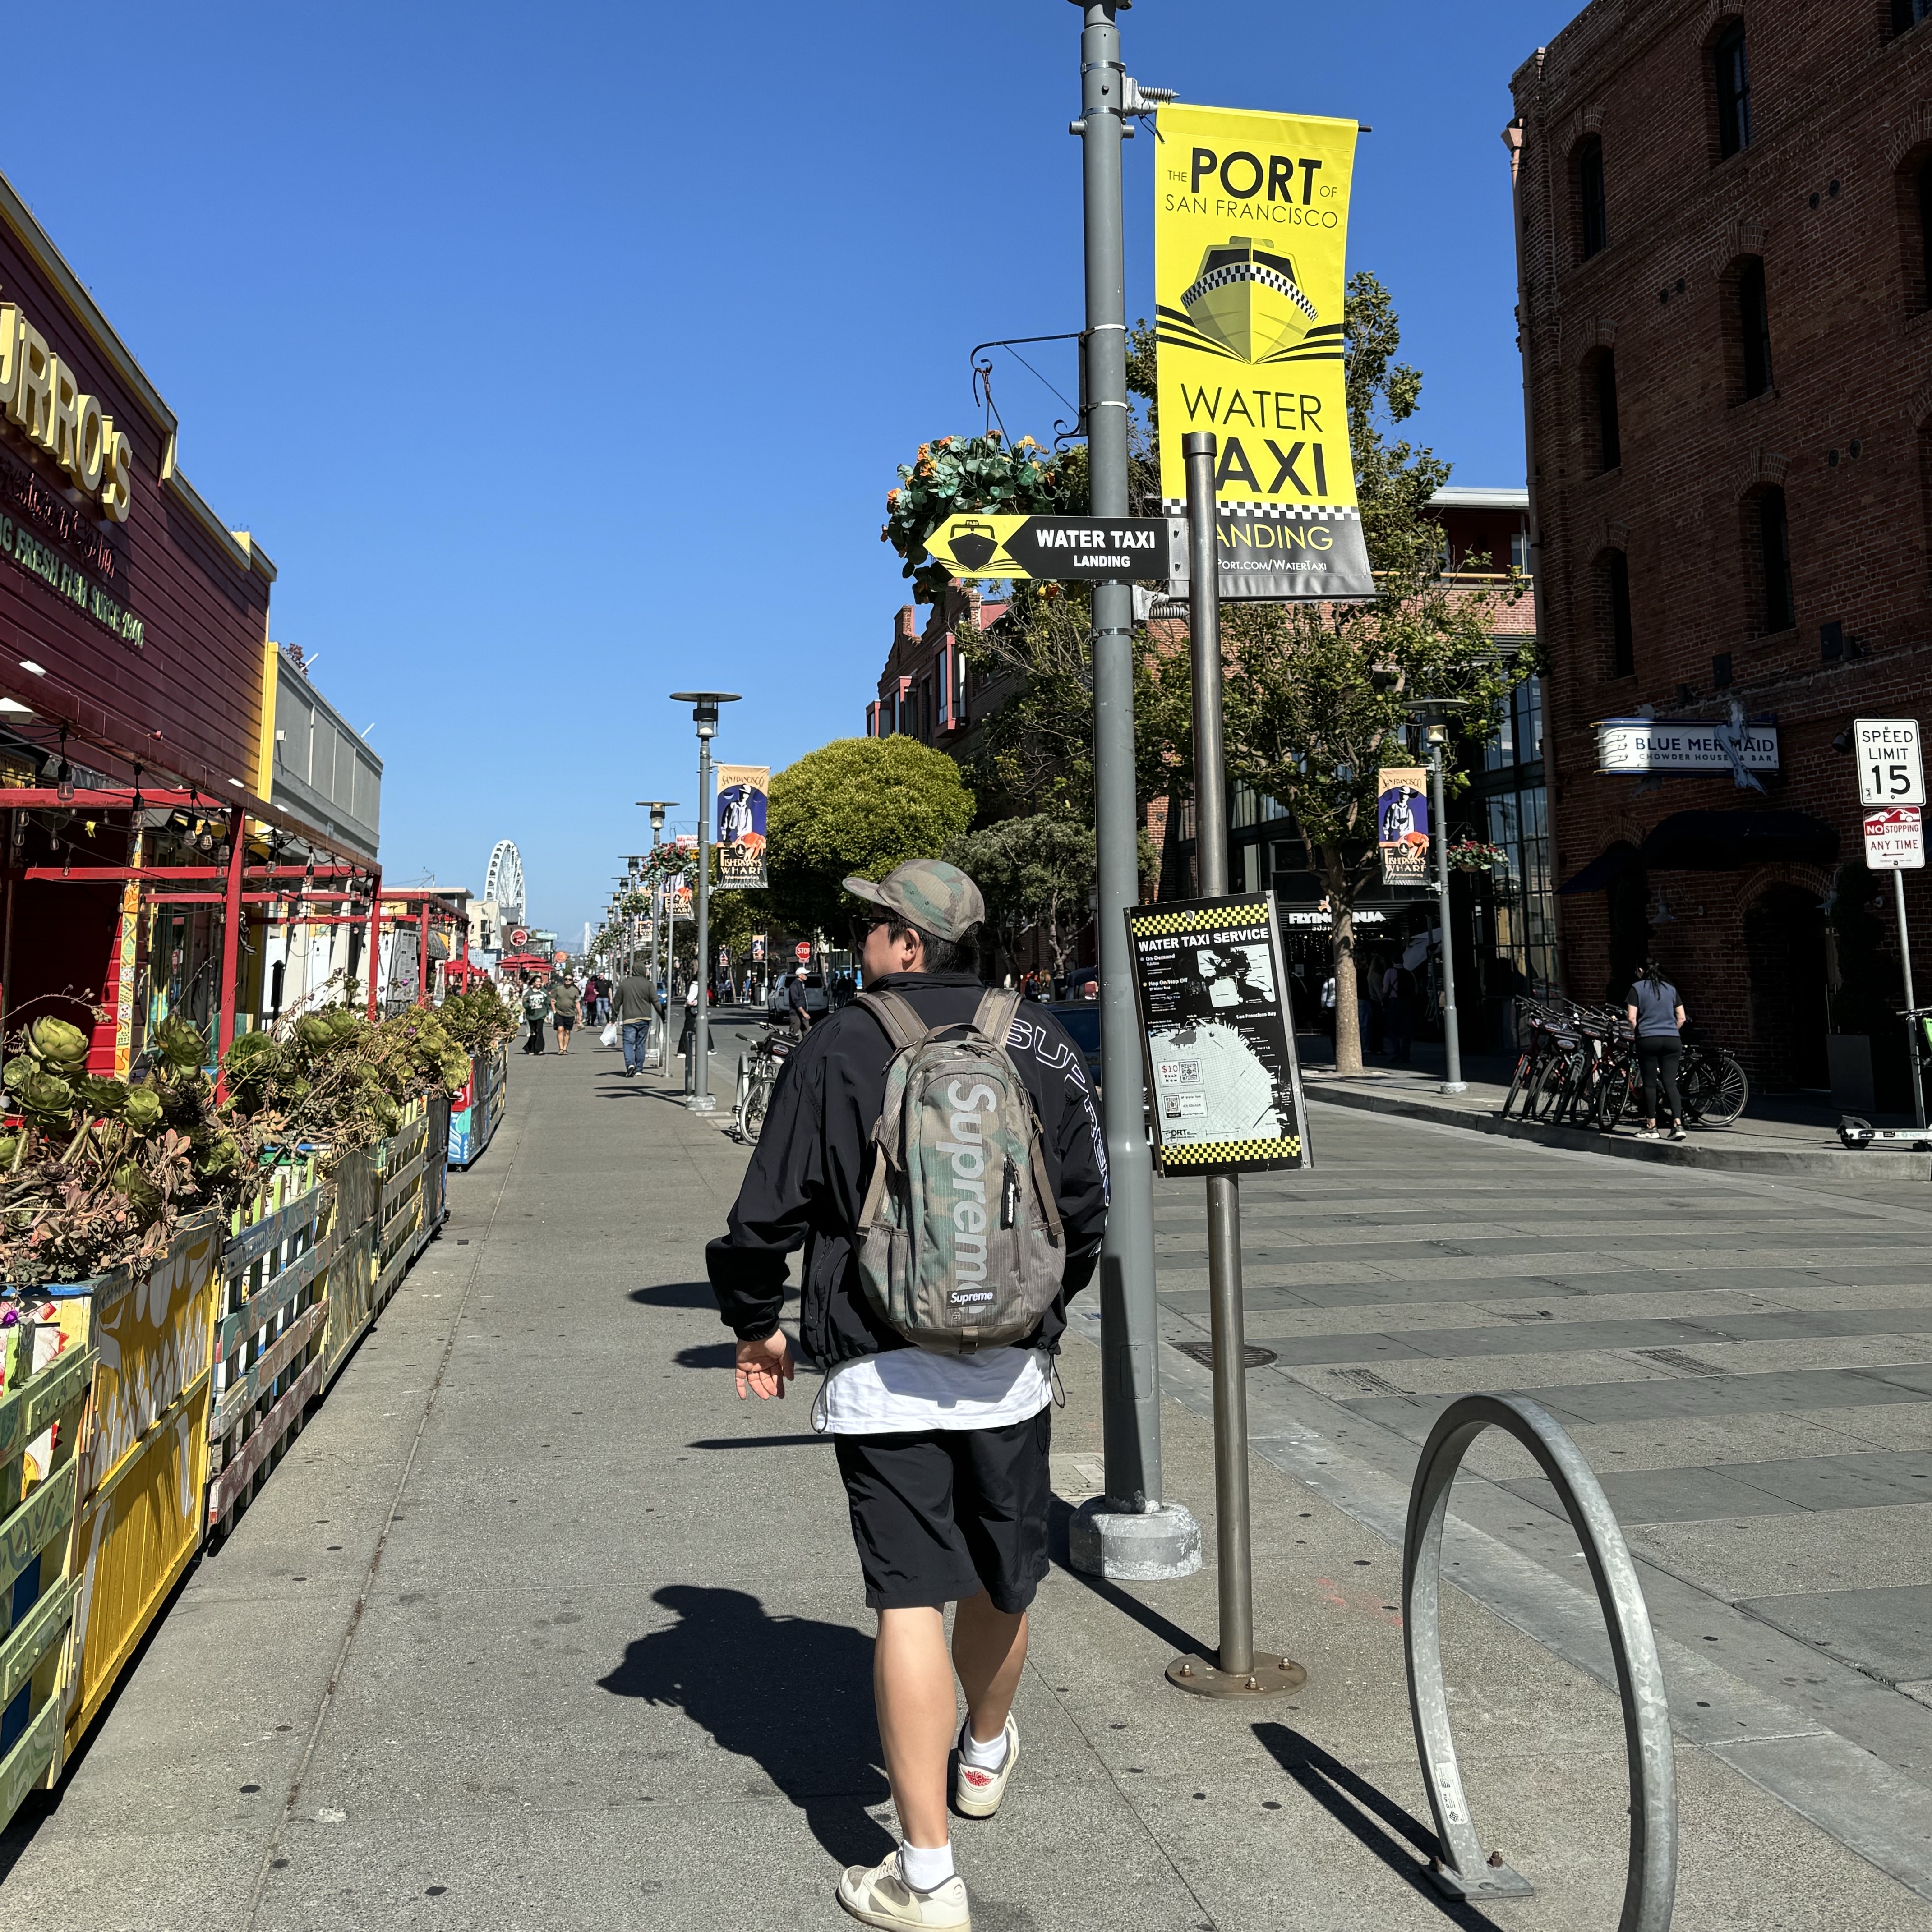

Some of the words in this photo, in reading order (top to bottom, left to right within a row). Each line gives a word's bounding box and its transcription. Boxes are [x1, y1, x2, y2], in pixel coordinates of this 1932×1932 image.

[1167, 170, 1187, 182] THE
[1191, 147, 1323, 206] PORT
[1319, 185, 1338, 198] OF
[1165, 193, 1207, 214] SAN
[1216, 199, 1338, 228] FRANCISCO
[1180, 383, 1324, 432] WATER
[1216, 437, 1328, 497] AXI
[1036, 529, 1107, 548] WATER
[1110, 530, 1156, 549] TAXI
[1216, 523, 1333, 551] ANDING
[1074, 555, 1131, 568] LANDING
[15, 527, 59, 587] FRESH
[60, 562, 88, 609] FISH
[89, 584, 121, 632] SINCE
[1636, 738, 1681, 750] BLUE
[1862, 731, 1913, 742] SPEED
[1869, 748, 1909, 760] LIMIT
[1872, 765, 1911, 795] 15
[1867, 825, 1884, 834] NO
[1885, 824, 1919, 833] STOPPING
[1871, 840, 1891, 851] ANY
[1895, 839, 1919, 850] TIME
[1289, 912, 1332, 924] FLYIN
[1138, 937, 1180, 952] WATER
[1181, 934, 1210, 947] TAXI
[1213, 928, 1269, 944] SERVICE
[1162, 1065, 1178, 1073] $10
[950, 1292, 993, 1305] Supreme
